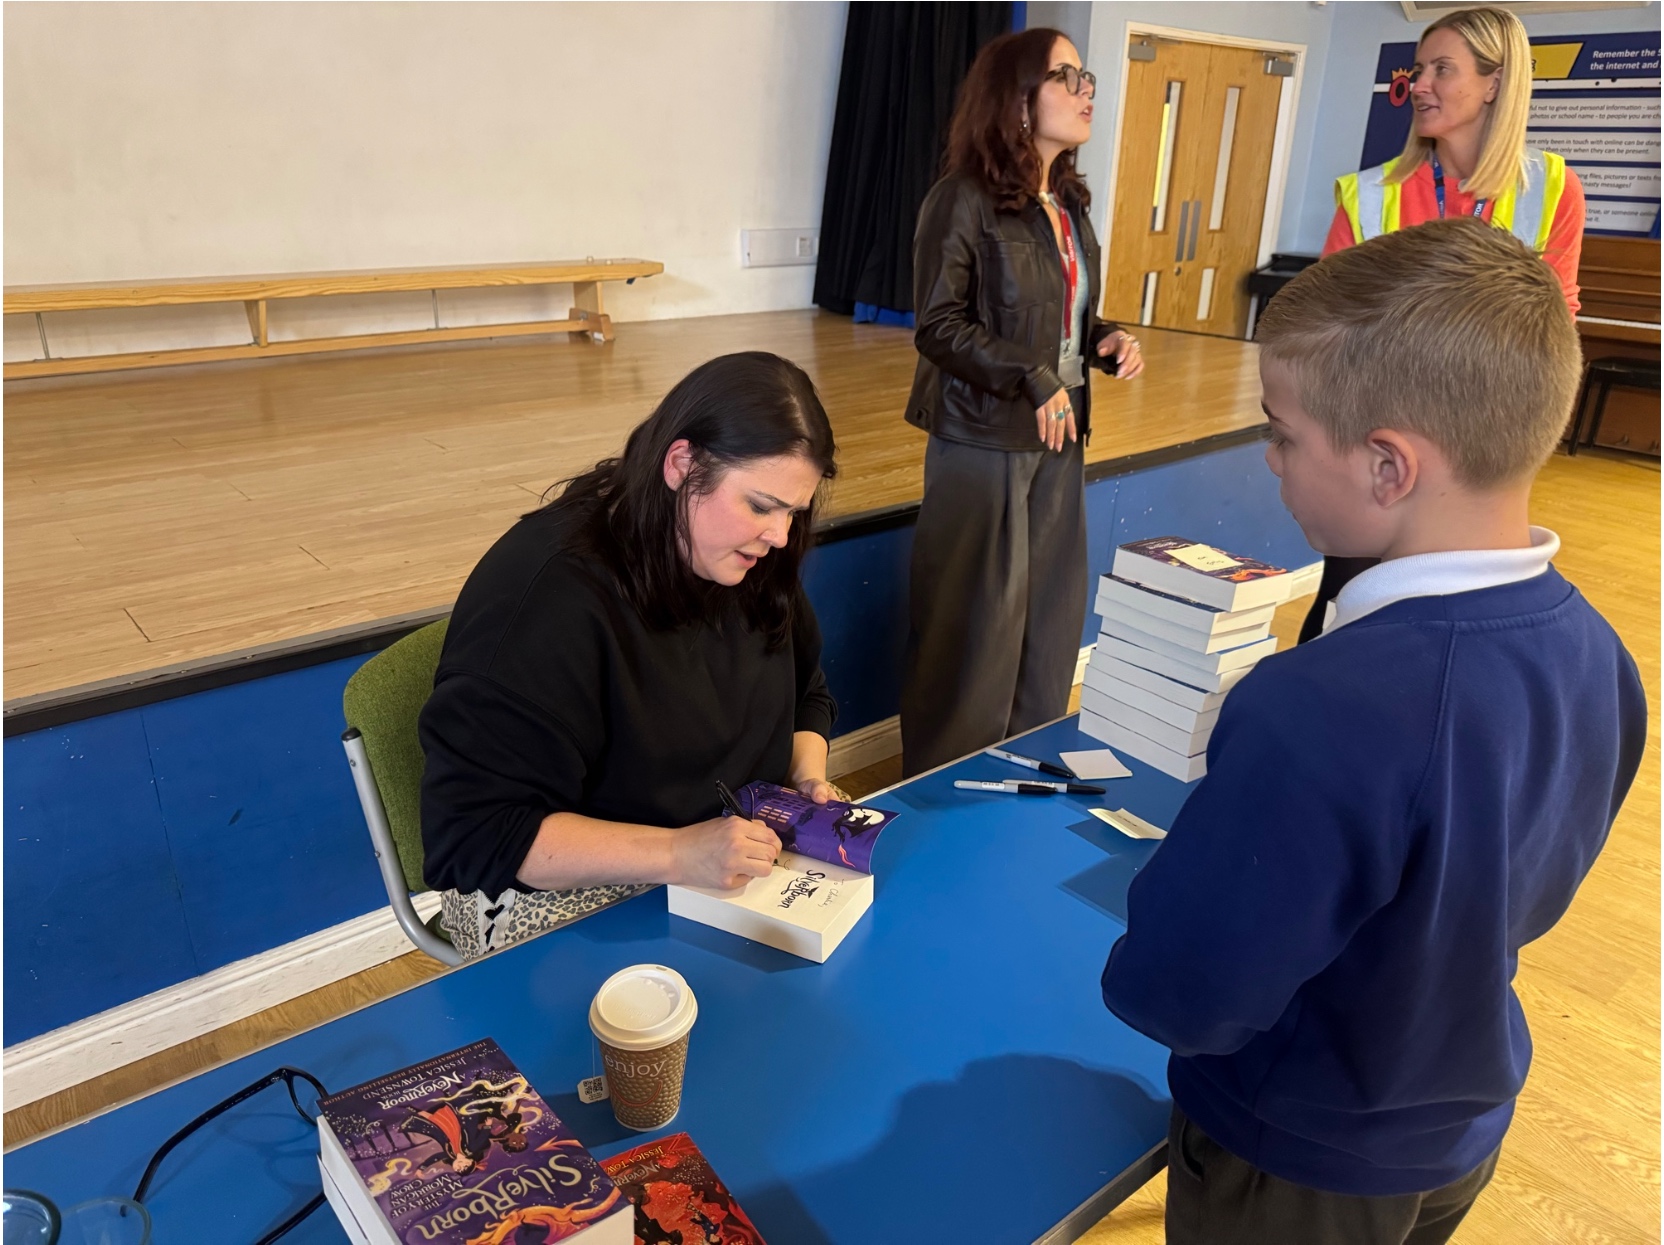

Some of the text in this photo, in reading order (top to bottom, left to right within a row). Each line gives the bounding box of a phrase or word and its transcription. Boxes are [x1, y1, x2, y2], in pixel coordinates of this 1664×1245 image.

[1590, 60, 1660, 70] the internet and
[1592, 49, 1639, 59] Remember
[1641, 48, 1656, 57] the
[322, 1041, 488, 1107] THE INTERNATIONALLY BESTSELLING AUTHOR
[604, 1054, 668, 1078] enjoy
[361, 1056, 468, 1101] JESSICA TOWNSEND
[628, 1145, 664, 1164] JESSICA
[390, 1179, 424, 1200] CROW
[390, 1173, 452, 1208] MORRIGAN
[391, 1179, 464, 1219] MYSTERY OF
